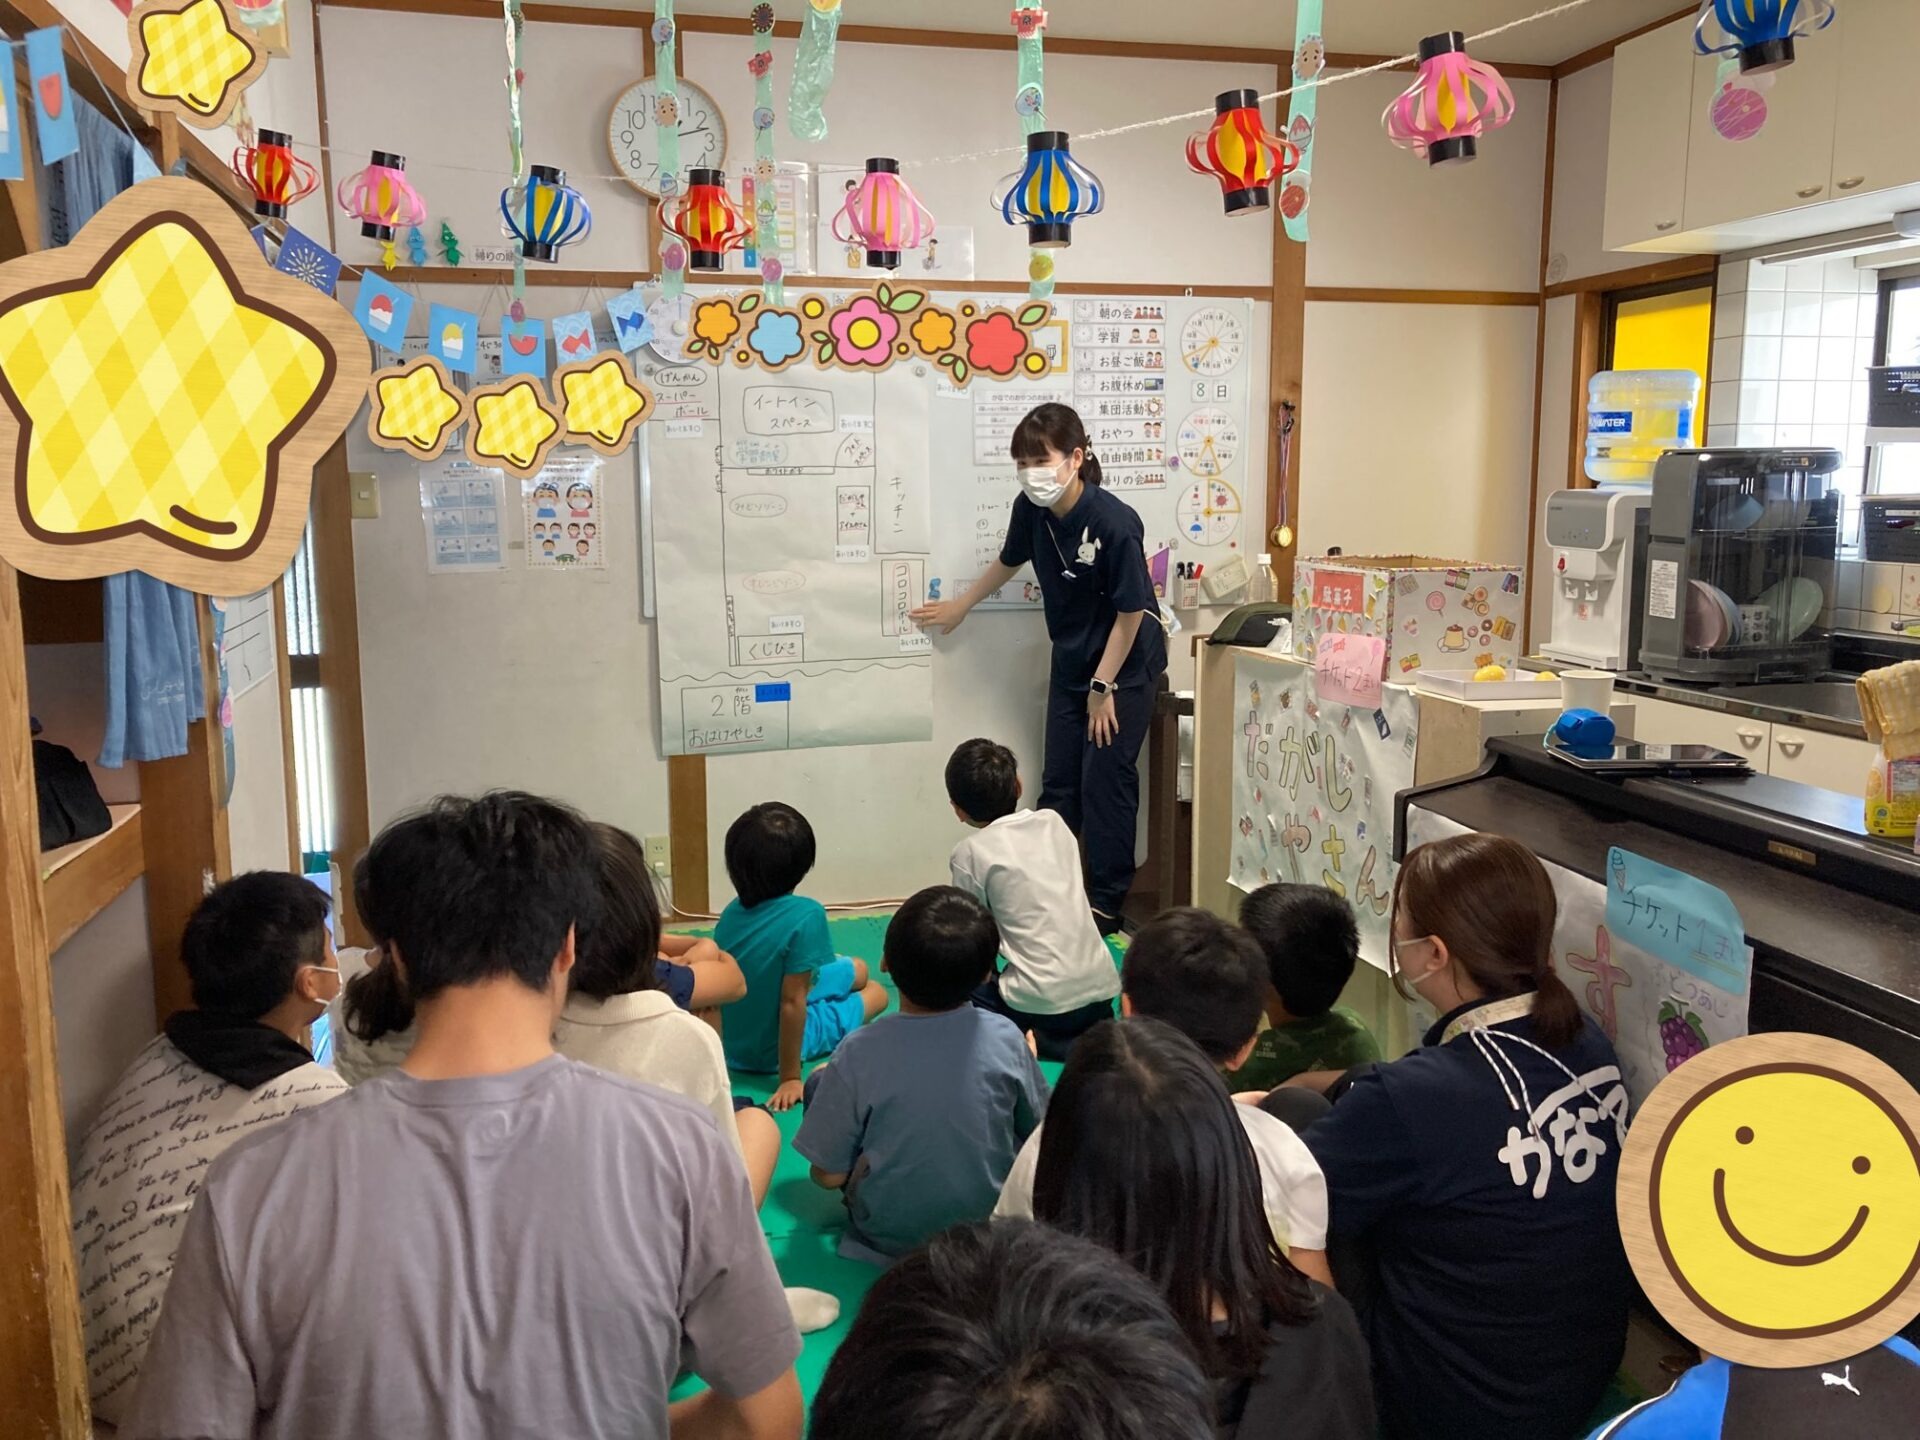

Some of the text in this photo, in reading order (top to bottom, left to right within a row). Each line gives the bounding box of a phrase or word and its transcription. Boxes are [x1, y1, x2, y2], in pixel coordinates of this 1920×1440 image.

[685, 97, 691, 117] 1
[626, 110, 646, 130] 10
[695, 110, 708, 130] 2
[620, 130, 635, 149] 9
[704, 132, 716, 152] 3
[630, 149, 642, 170] 8
[695, 152, 708, 168] 4
[647, 163, 659, 181] 7
[1099, 307, 1133, 320] 朝の会
[1097, 331, 1120, 344] 学習
[1099, 356, 1145, 368] お昼ご飯
[660, 371, 701, 384] げんかん
[1099, 379, 1144, 392] お腹休め
[655, 390, 697, 402] スーパー
[1196, 382, 1227, 398] 8 日
[753, 394, 817, 410] イートイン
[1099, 403, 1144, 416] 集団活動
[675, 405, 709, 418] ボール
[770, 417, 811, 430] スペース
[1100, 428, 1134, 439] おやつ
[1100, 450, 1145, 463] 自由時間
[889, 476, 906, 534] キッチン
[748, 642, 797, 660] くじびき
[711, 694, 752, 717] 2階
[1243, 709, 1353, 813] だがし
[1280, 813, 1391, 917] やさん
